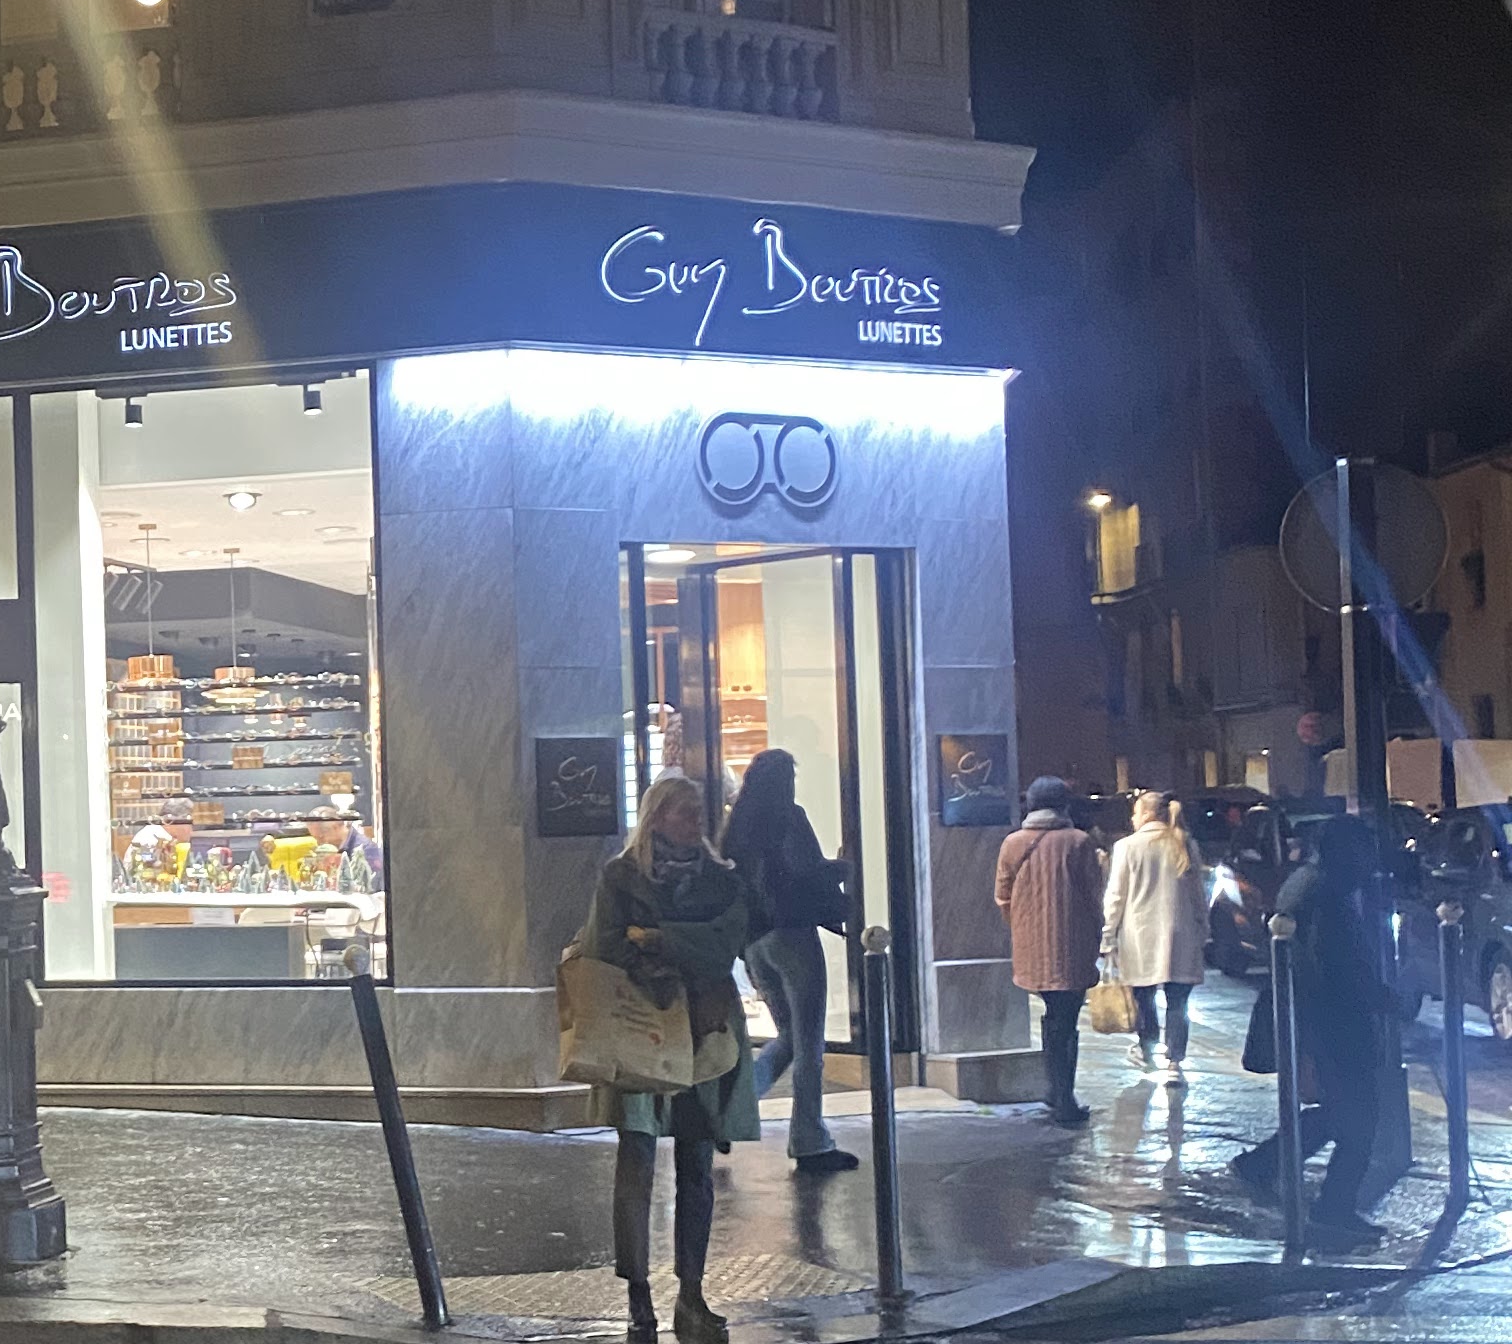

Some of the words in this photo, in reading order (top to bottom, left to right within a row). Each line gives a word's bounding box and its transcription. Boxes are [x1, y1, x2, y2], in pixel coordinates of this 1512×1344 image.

[601, 224, 727, 347] Guy
[120, 321, 233, 352] LUNETTES
[858, 320, 943, 346] LUNETTES
